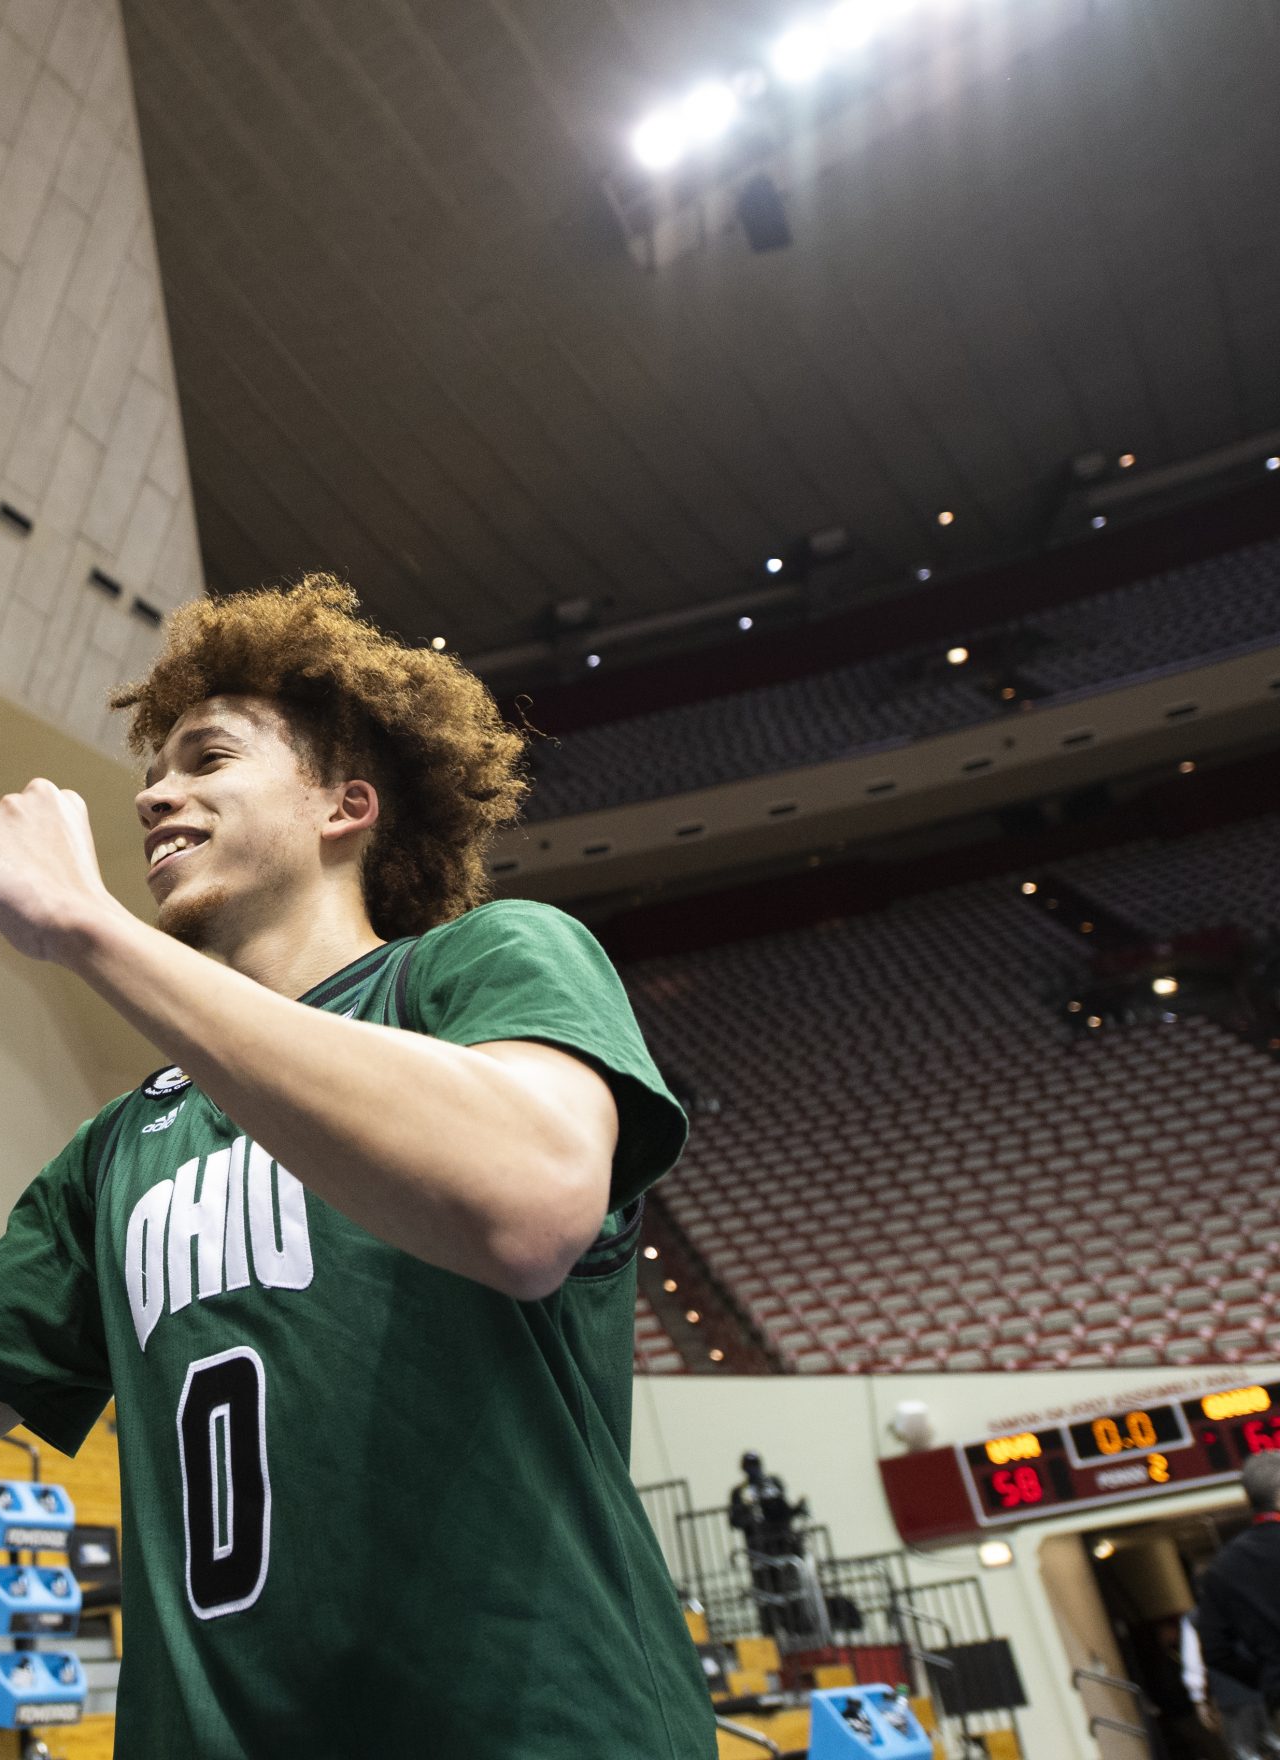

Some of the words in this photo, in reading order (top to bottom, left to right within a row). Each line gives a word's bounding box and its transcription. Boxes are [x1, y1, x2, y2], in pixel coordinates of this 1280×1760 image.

[124, 1135, 314, 1353] OHIO
[176, 1345, 272, 1620] 0
[992, 1465, 1043, 1508] 58
[1092, 1410, 1158, 1456] 0.0
